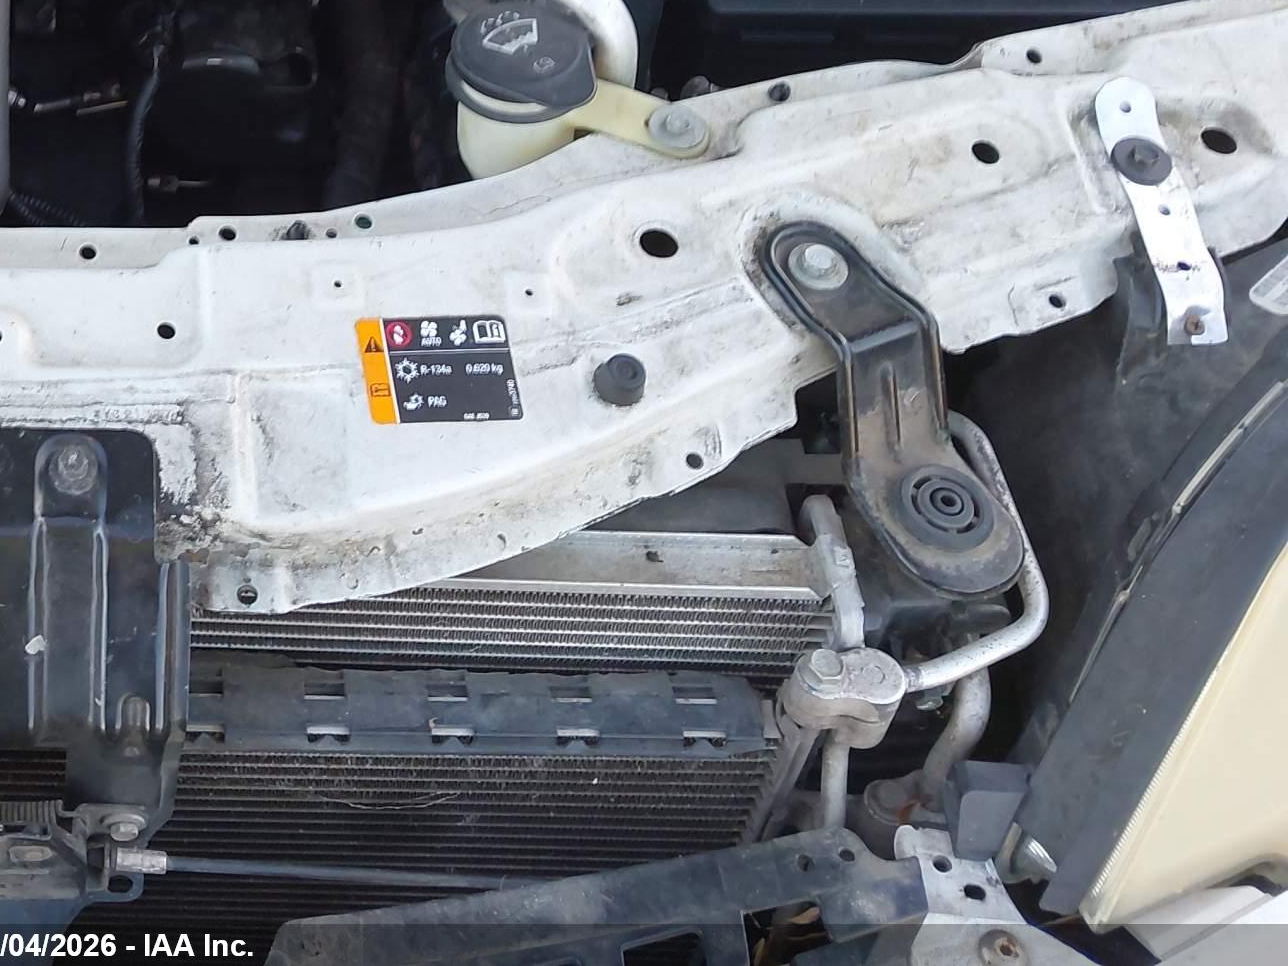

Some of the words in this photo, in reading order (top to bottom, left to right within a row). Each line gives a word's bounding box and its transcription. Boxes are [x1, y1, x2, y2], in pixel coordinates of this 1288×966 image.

[421, 337, 442, 347] AUTO
[420, 364, 453, 376] R-134a
[492, 362, 504, 376] kg
[428, 396, 447, 407] PAG
